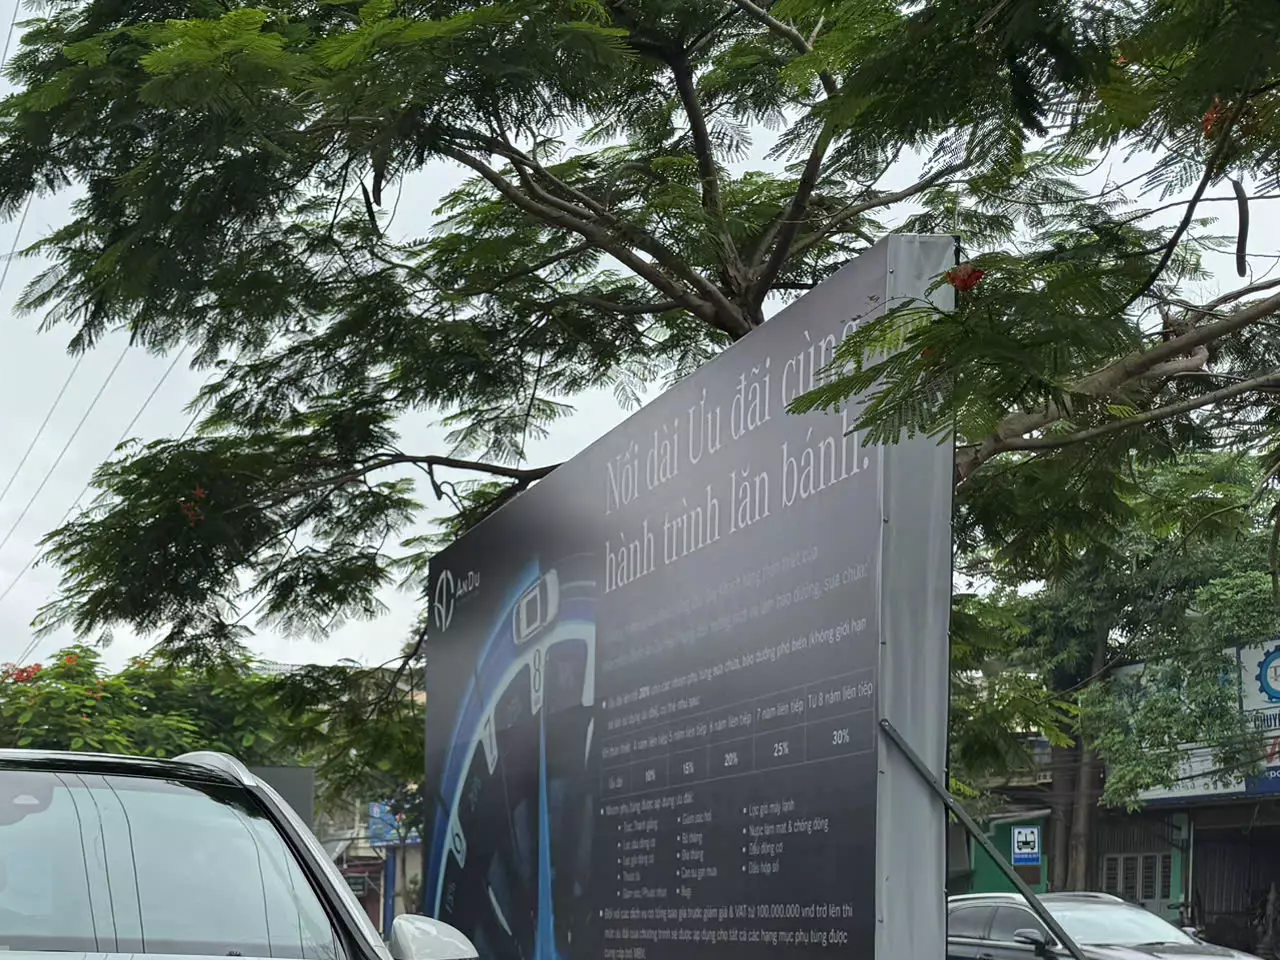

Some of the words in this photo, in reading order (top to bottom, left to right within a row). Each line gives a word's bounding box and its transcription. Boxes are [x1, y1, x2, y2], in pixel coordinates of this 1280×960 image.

[605, 440, 640, 516] Nối
[646, 418, 680, 491] dài
[687, 388, 721, 465] Ưu
[730, 356, 772, 440] đãi
[604, 516, 656, 594] hành
[663, 485, 721, 565] trình
[728, 463, 772, 534] lăn
[781, 409, 869, 510] bánh.
[773, 740, 790, 758] 25%
[831, 728, 850, 746] 30%
[788, 819, 793, 833] &
[757, 903, 800, 919] 100.000.000
